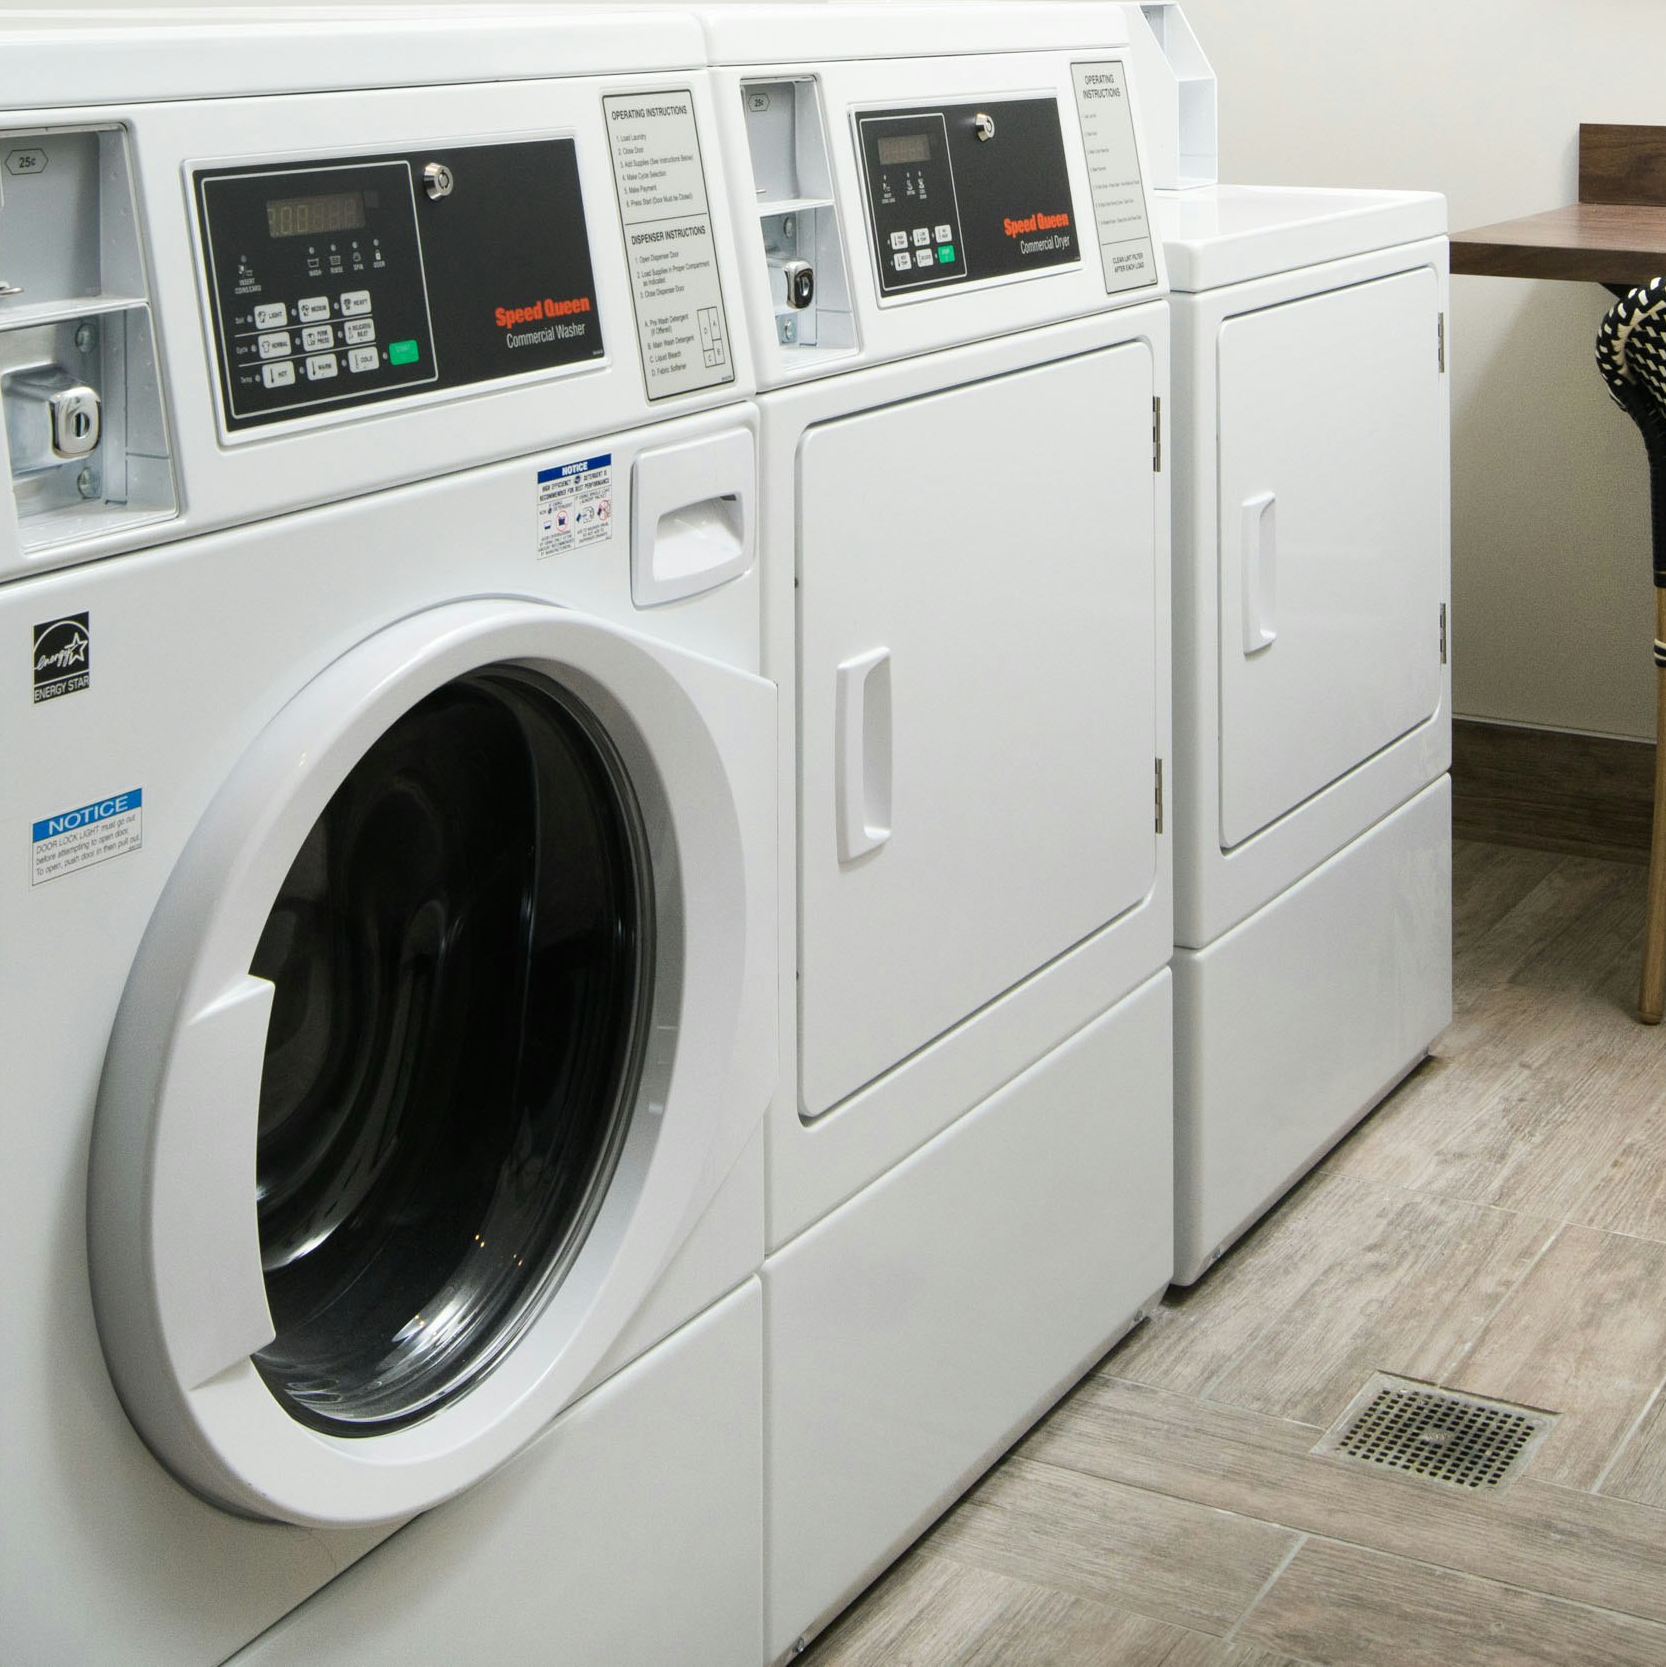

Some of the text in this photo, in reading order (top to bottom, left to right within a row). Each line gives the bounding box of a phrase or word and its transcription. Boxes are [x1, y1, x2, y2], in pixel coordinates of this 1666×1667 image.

[1085, 74, 1114, 85] OPERATING
[1083, 88, 1121, 99] INSTRUCTIONS
[611, 105, 688, 120] OPERATING INSTRUCTIONS
[631, 225, 706, 245] DISPENSER INSTRUCTIONS
[1004, 212, 1069, 239] Speed Queen
[1020, 234, 1070, 254] Commercial Dryer
[495, 297, 590, 329] Speed Queen
[506, 321, 585, 349] Commercial Washer
[562, 461, 588, 476] NOTICE
[34, 675, 89, 702] ENERGY STAR
[48, 795, 129, 835] NOTICE
[36, 839, 57, 854] DOOR
[59, 834, 78, 846] LOCK
[79, 826, 99, 840] LIGHT
